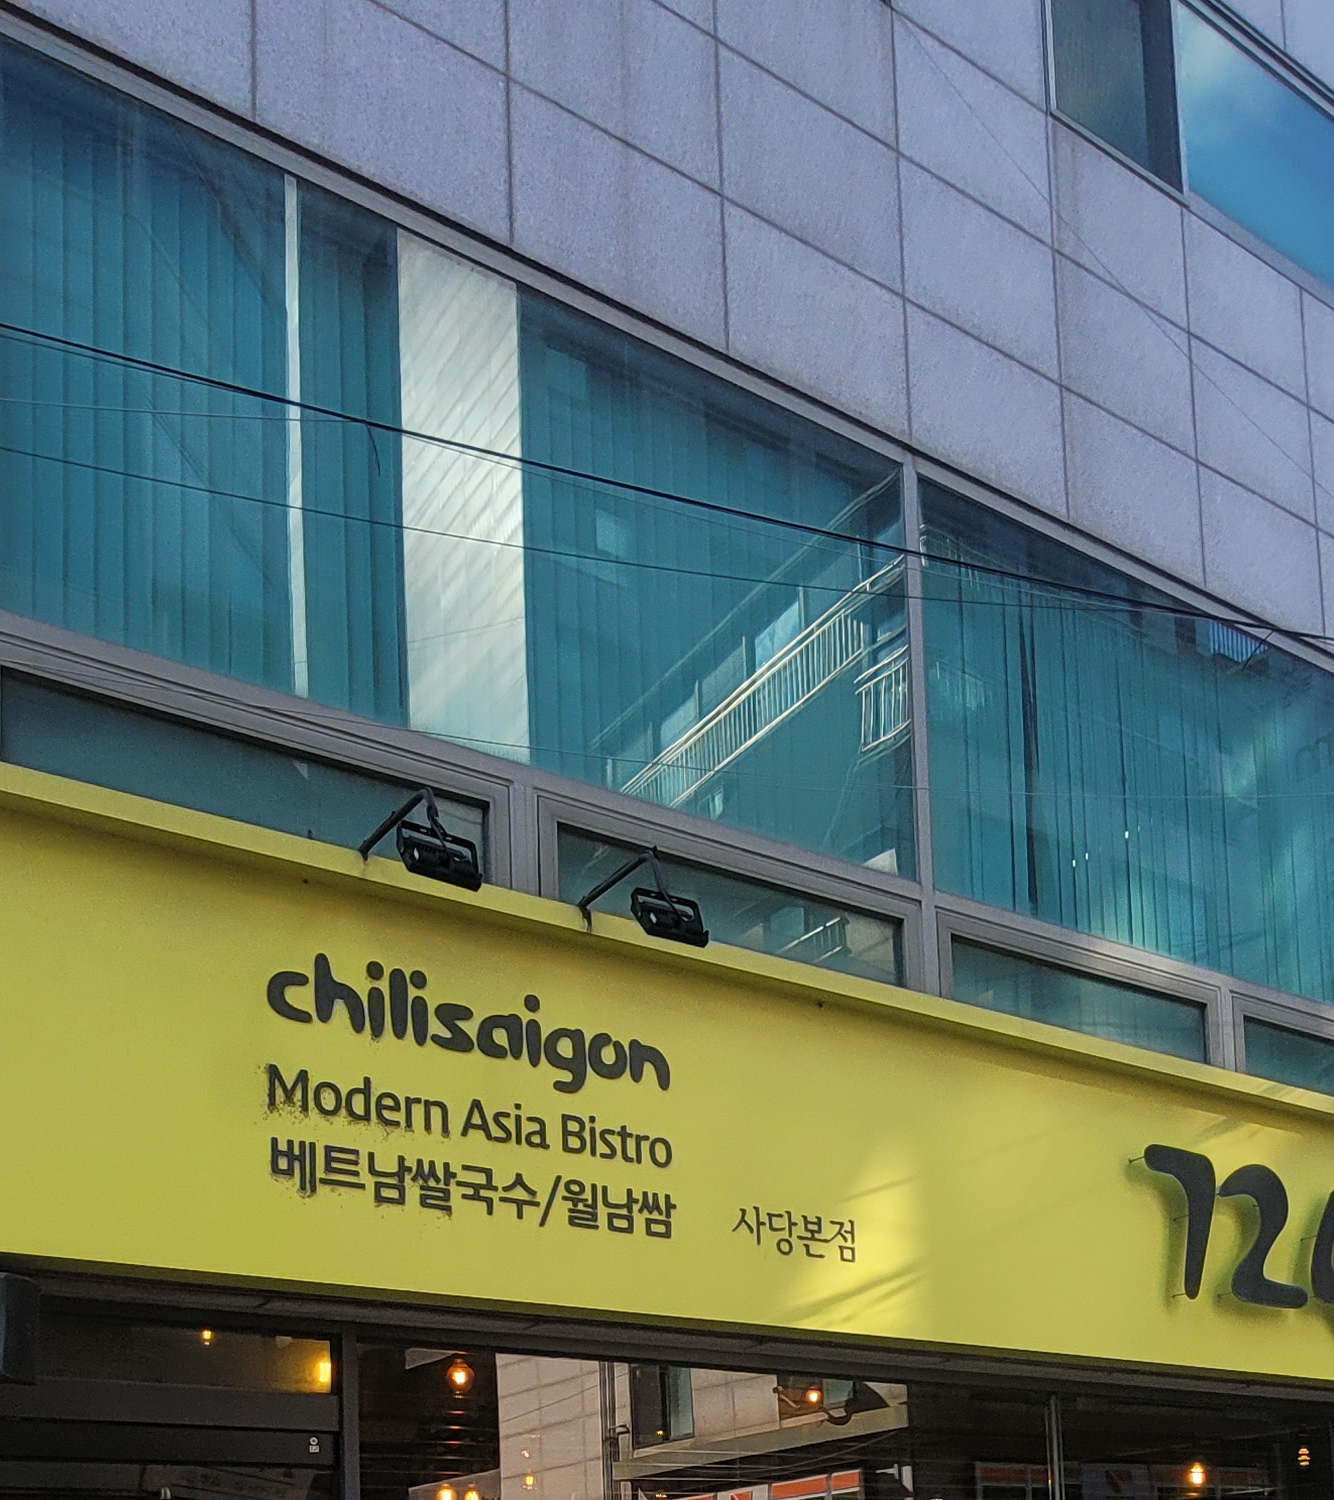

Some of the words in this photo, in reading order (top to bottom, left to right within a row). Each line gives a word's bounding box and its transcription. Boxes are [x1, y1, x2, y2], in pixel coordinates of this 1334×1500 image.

[266, 952, 671, 1093] chilisaigon
[267, 1063, 450, 1138] Modern
[460, 1099, 550, 1150] Asia
[561, 1113, 673, 1168] Bistro
[269, 1136, 677, 1240] 베트남쌀국수/월남쌈
[731, 1204, 858, 1264] 사당본점
